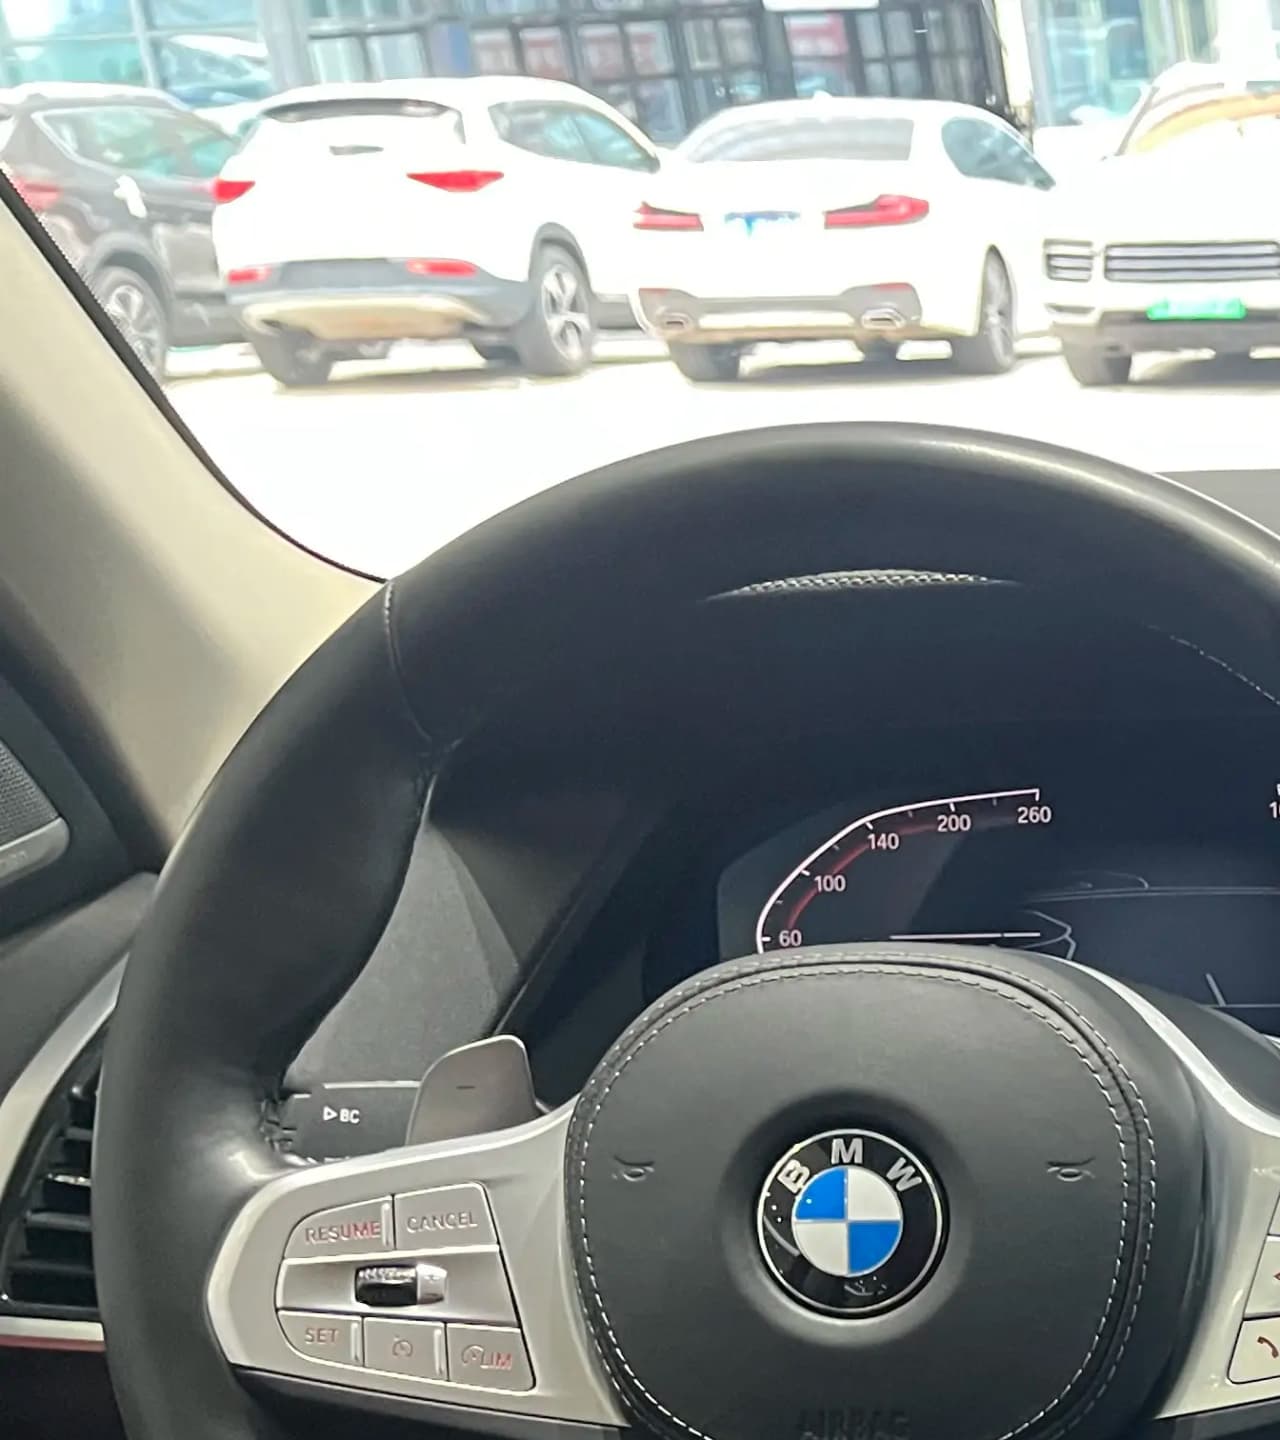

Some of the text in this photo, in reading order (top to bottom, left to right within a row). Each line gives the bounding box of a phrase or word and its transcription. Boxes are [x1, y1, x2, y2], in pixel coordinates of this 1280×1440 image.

[1017, 806, 1052, 823] 260
[937, 815, 971, 832] 200
[868, 833, 900, 850] 140
[814, 875, 846, 892] 100
[779, 929, 802, 947] 60
[339, 1108, 360, 1124] BC
[777, 1137, 922, 1193] BMW
[407, 1211, 478, 1233] CANCEL
[305, 1222, 381, 1246] RESUME
[304, 1328, 340, 1344] SET
[480, 1351, 513, 1370] LIM
